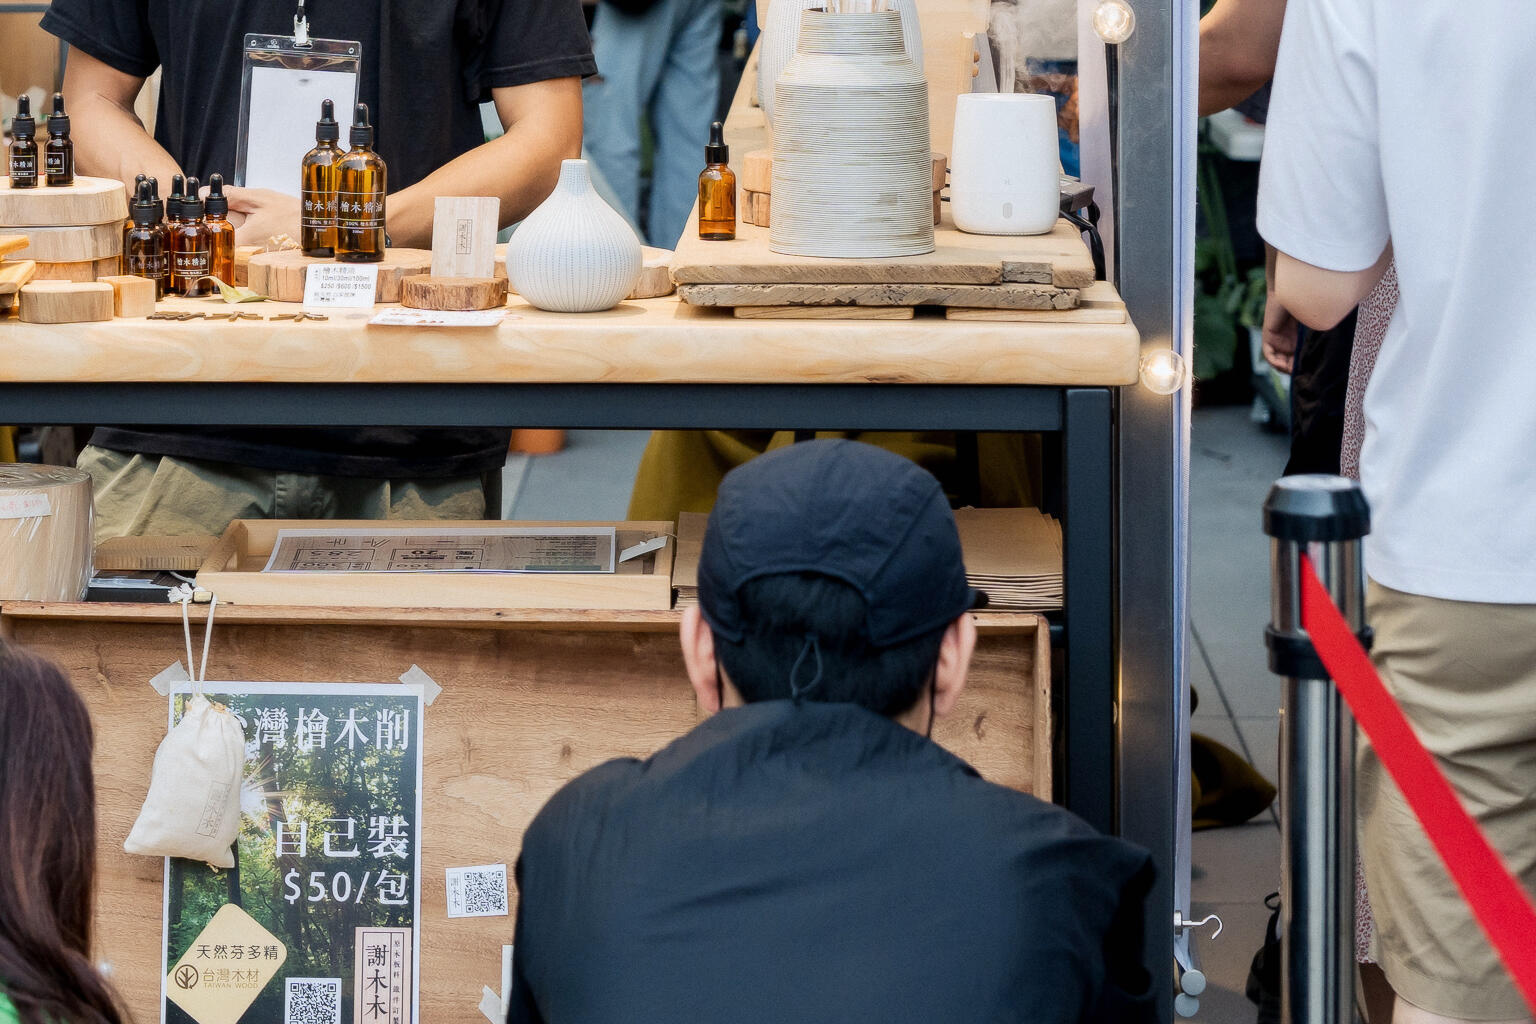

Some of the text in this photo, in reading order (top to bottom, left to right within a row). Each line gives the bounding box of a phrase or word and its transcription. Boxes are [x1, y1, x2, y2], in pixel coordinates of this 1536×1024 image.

[340, 201, 383, 214] 檜木精油
[176, 257, 207, 267] 檜木精油
[237, 707, 411, 751] 灣檜木削
[276, 815, 410, 860] 自己裝
[284, 867, 409, 906] $50/包
[196, 944, 278, 960] 天然芬多精
[202, 968, 260, 982] 台灣木材
[365, 944, 390, 1020] 謝木木
